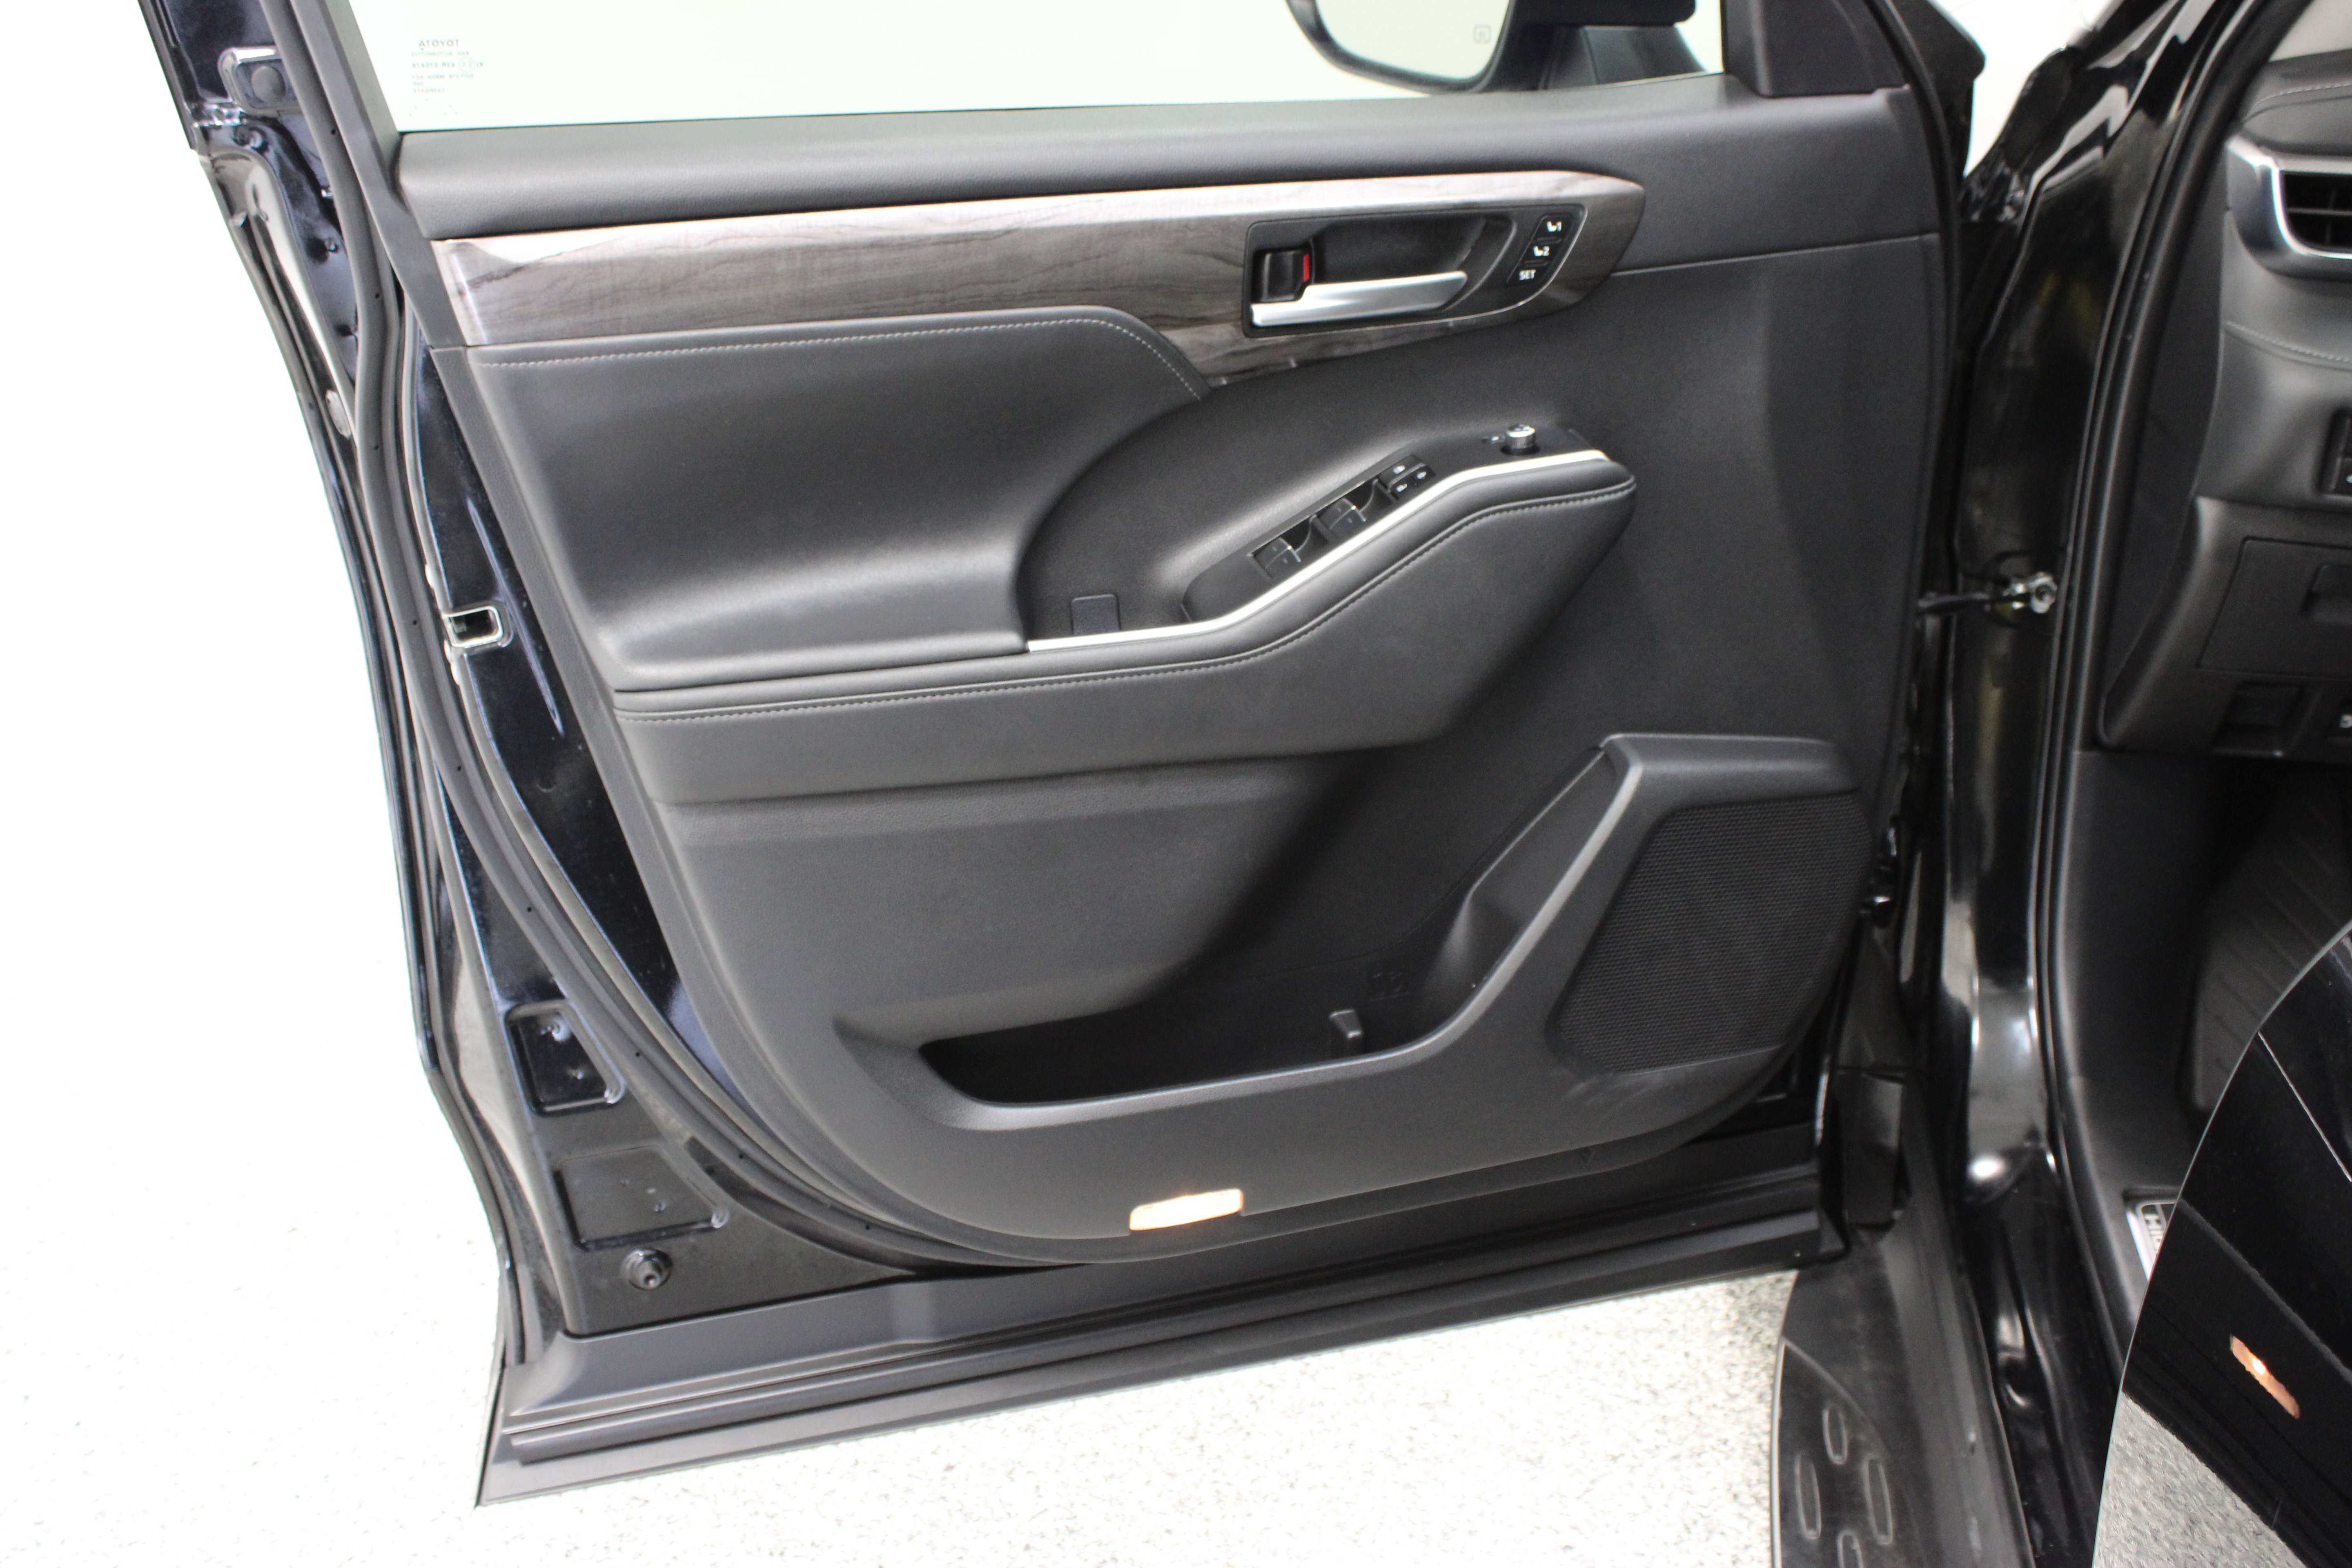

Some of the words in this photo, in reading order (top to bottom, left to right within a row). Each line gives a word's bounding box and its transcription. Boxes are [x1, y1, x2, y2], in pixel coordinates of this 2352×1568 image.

[1557, 221, 1562, 232] 1
[1542, 246, 1550, 256] 2
[1519, 270, 1536, 281] SET
